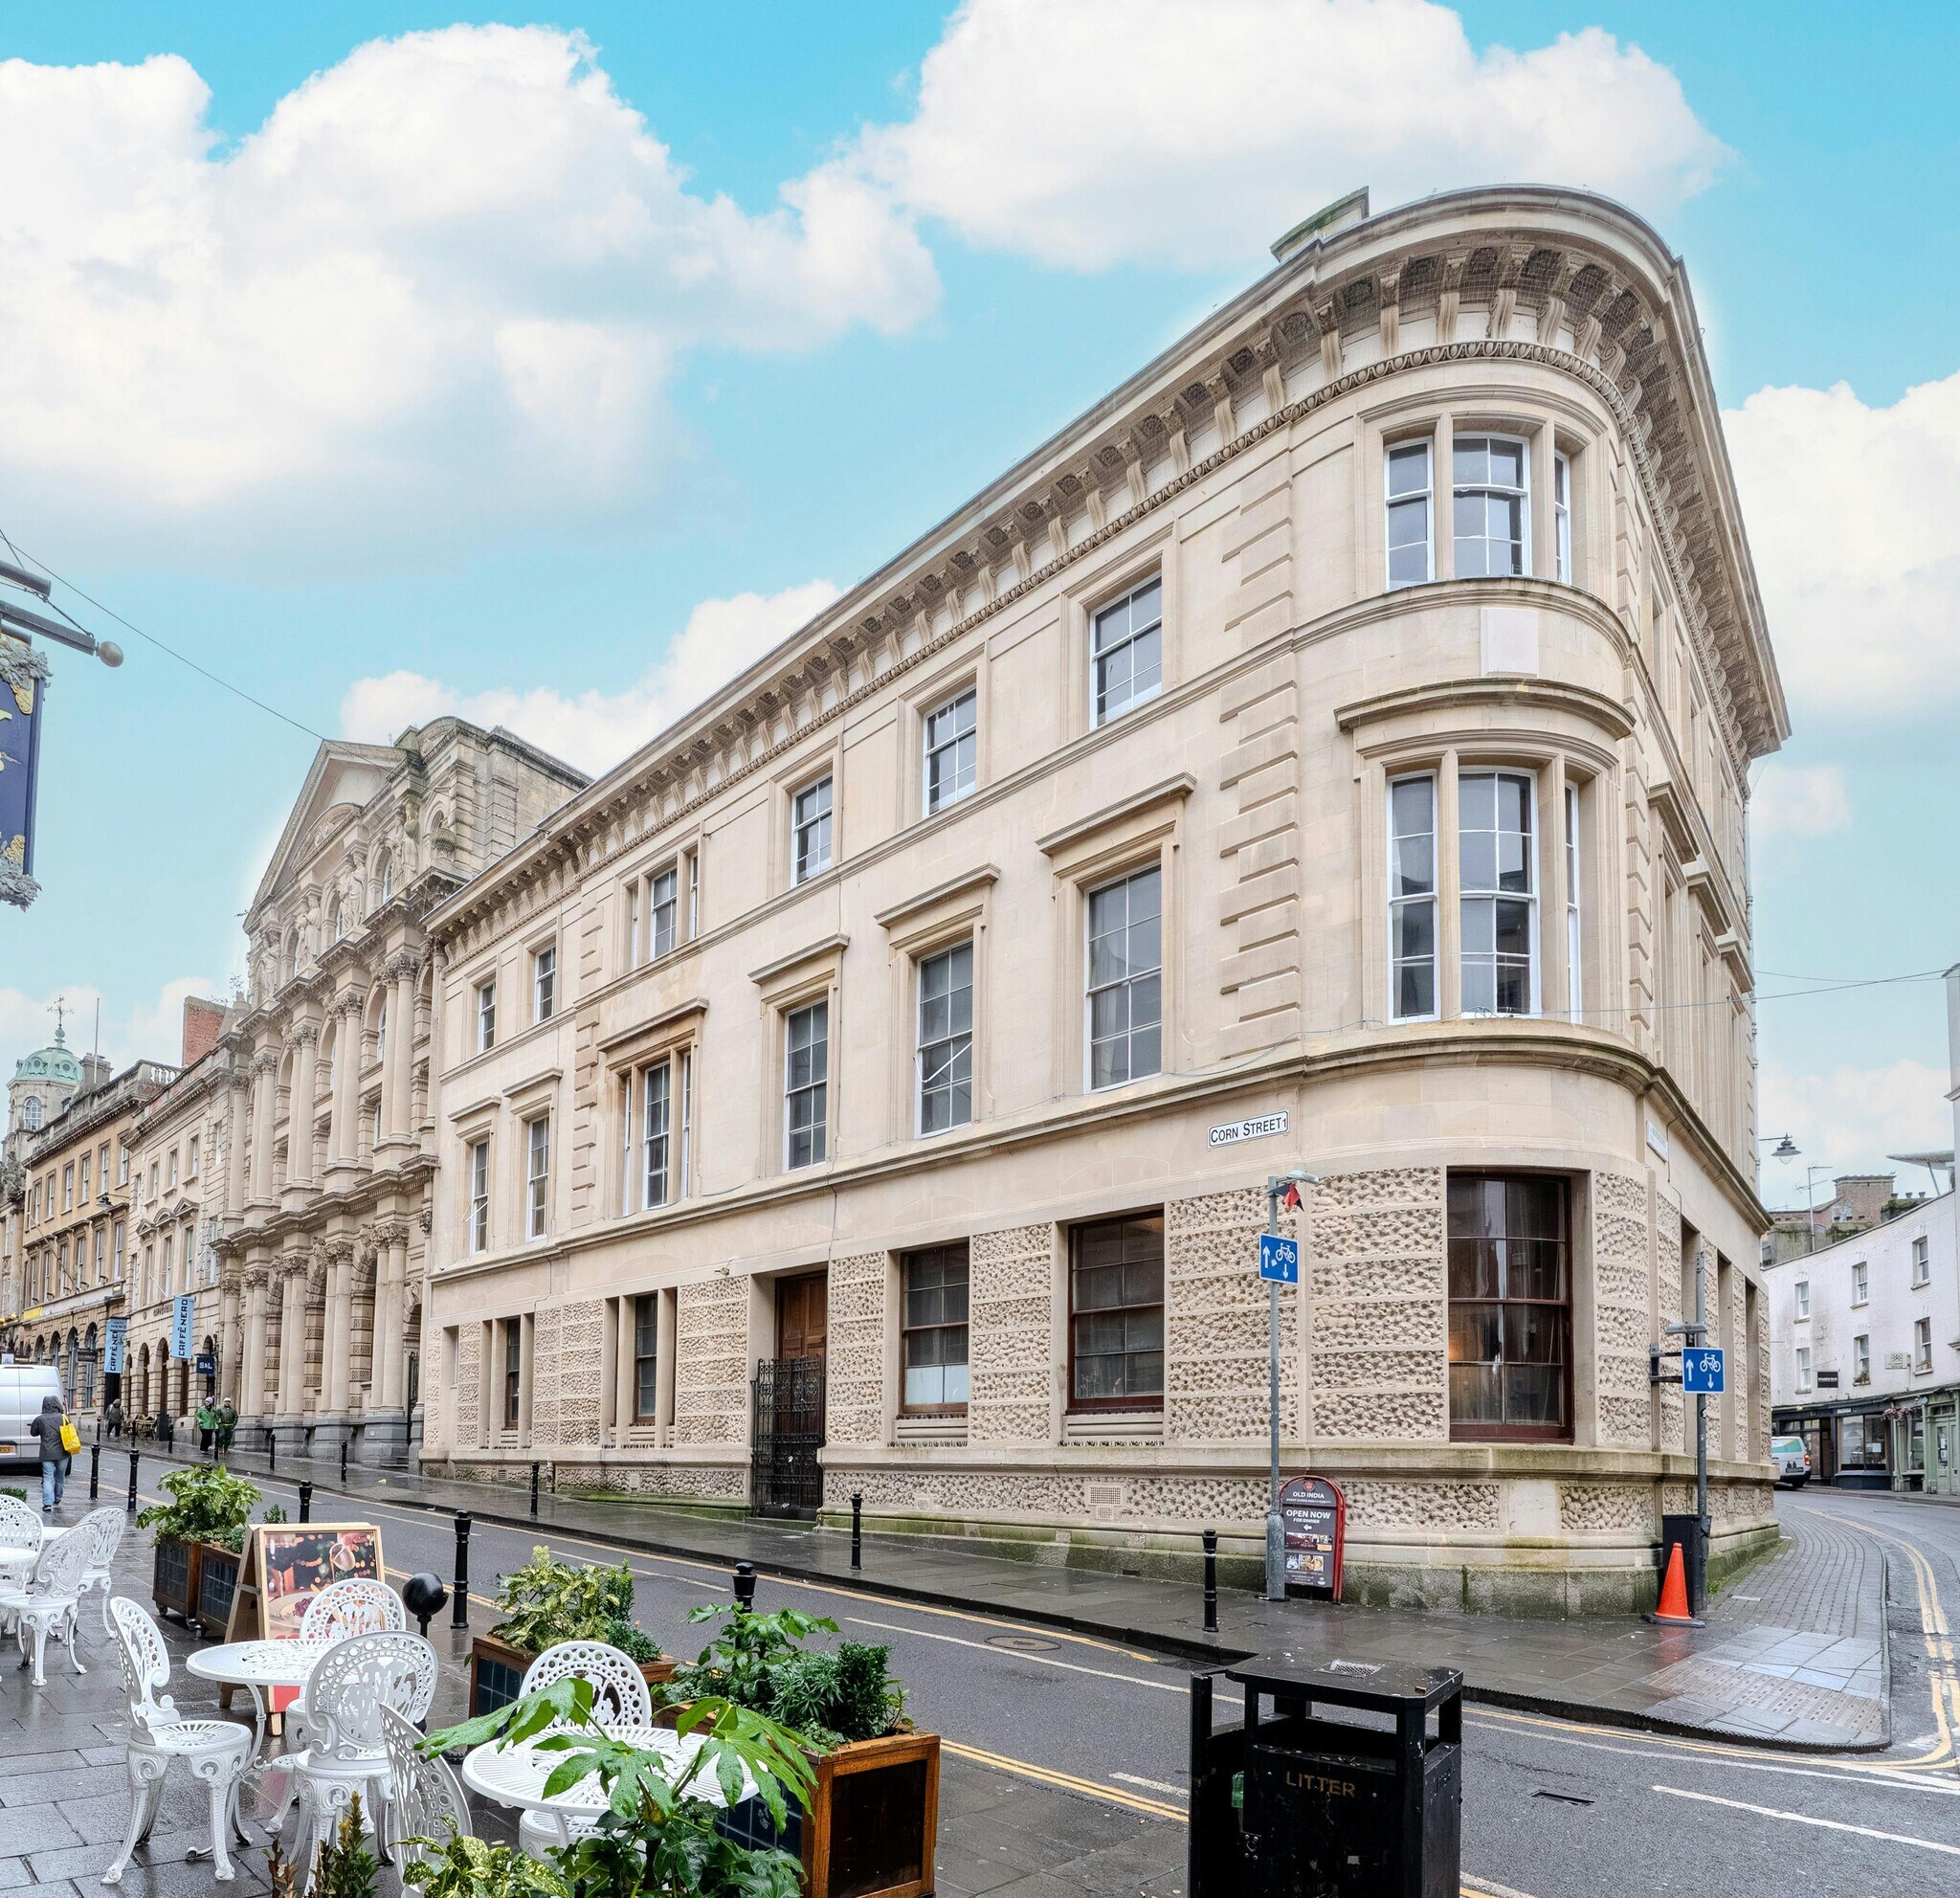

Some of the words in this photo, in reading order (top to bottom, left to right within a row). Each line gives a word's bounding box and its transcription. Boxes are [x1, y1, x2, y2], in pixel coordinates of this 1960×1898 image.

[1242, 1117, 1282, 1136] STREET
[180, 1299, 189, 1326] NERO
[1286, 1509, 1309, 1518] OPEN
[1285, 1771, 1356, 1798] LITTER
